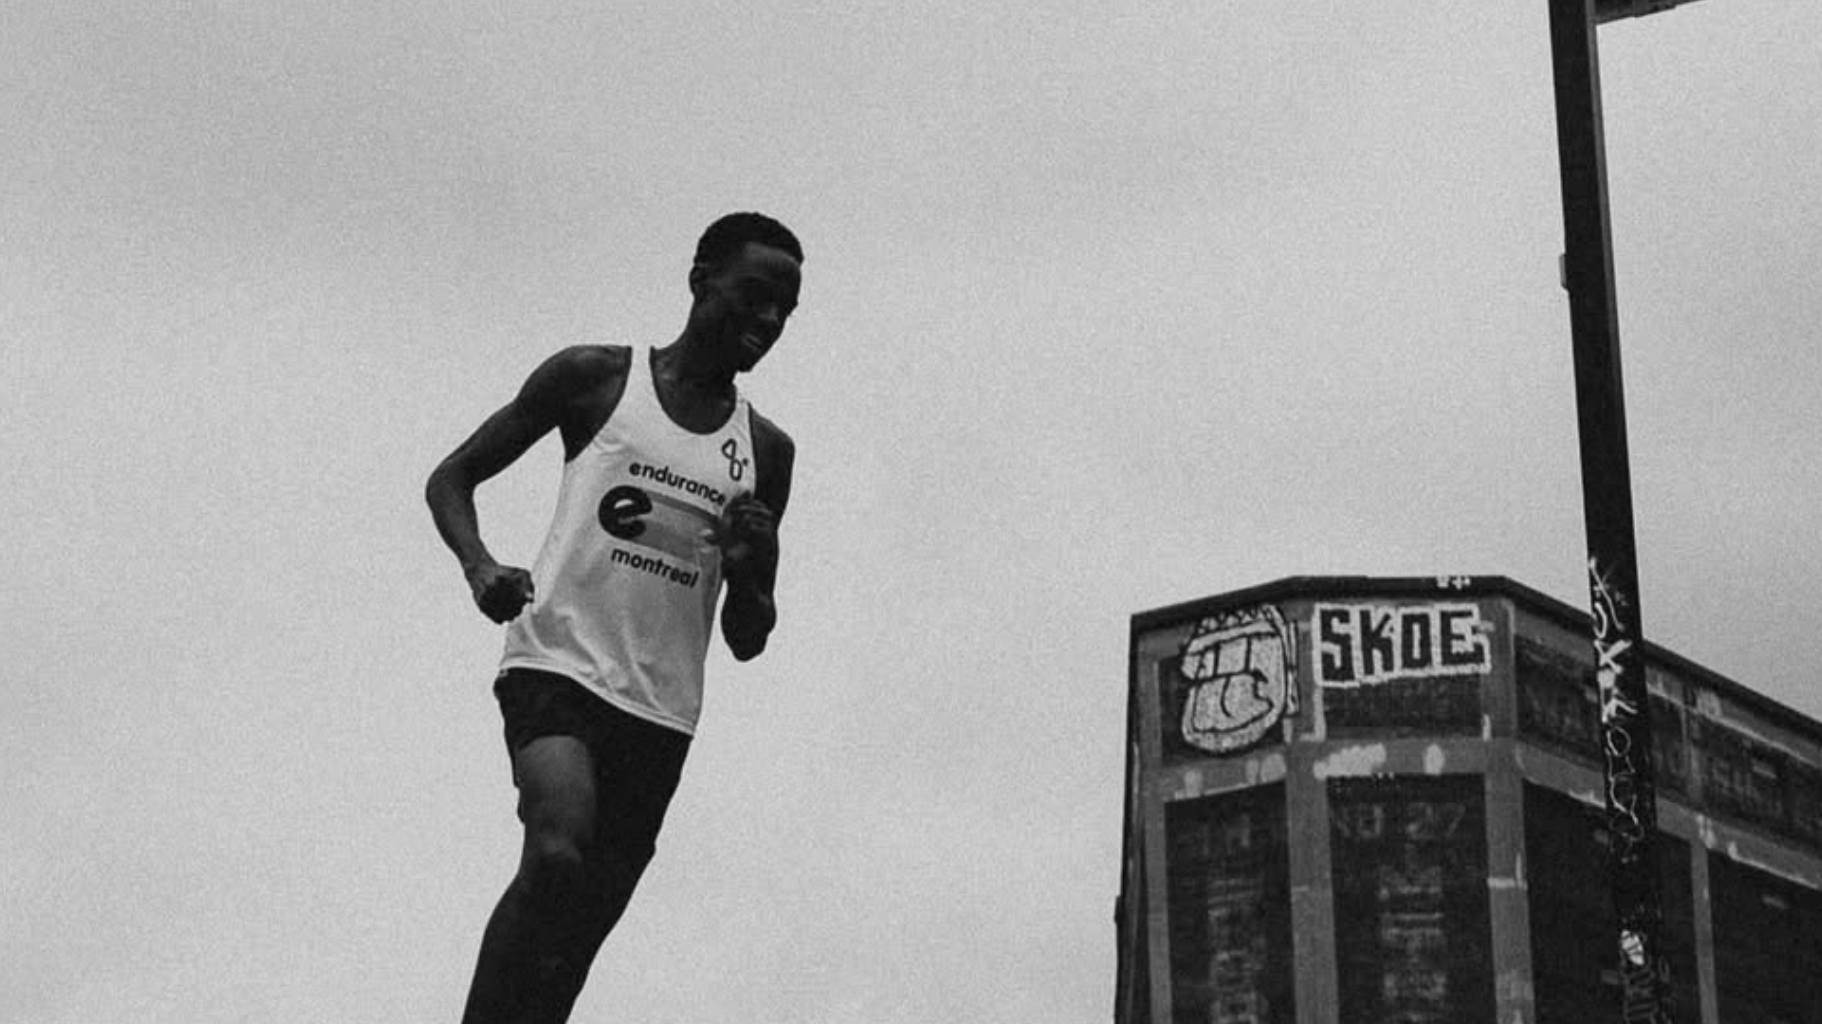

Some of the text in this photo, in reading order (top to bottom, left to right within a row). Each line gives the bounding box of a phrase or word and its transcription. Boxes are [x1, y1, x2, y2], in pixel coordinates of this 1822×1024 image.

[629, 461, 726, 506] endurance
[611, 548, 699, 588] montreal
[1317, 606, 1487, 684] SKOE
